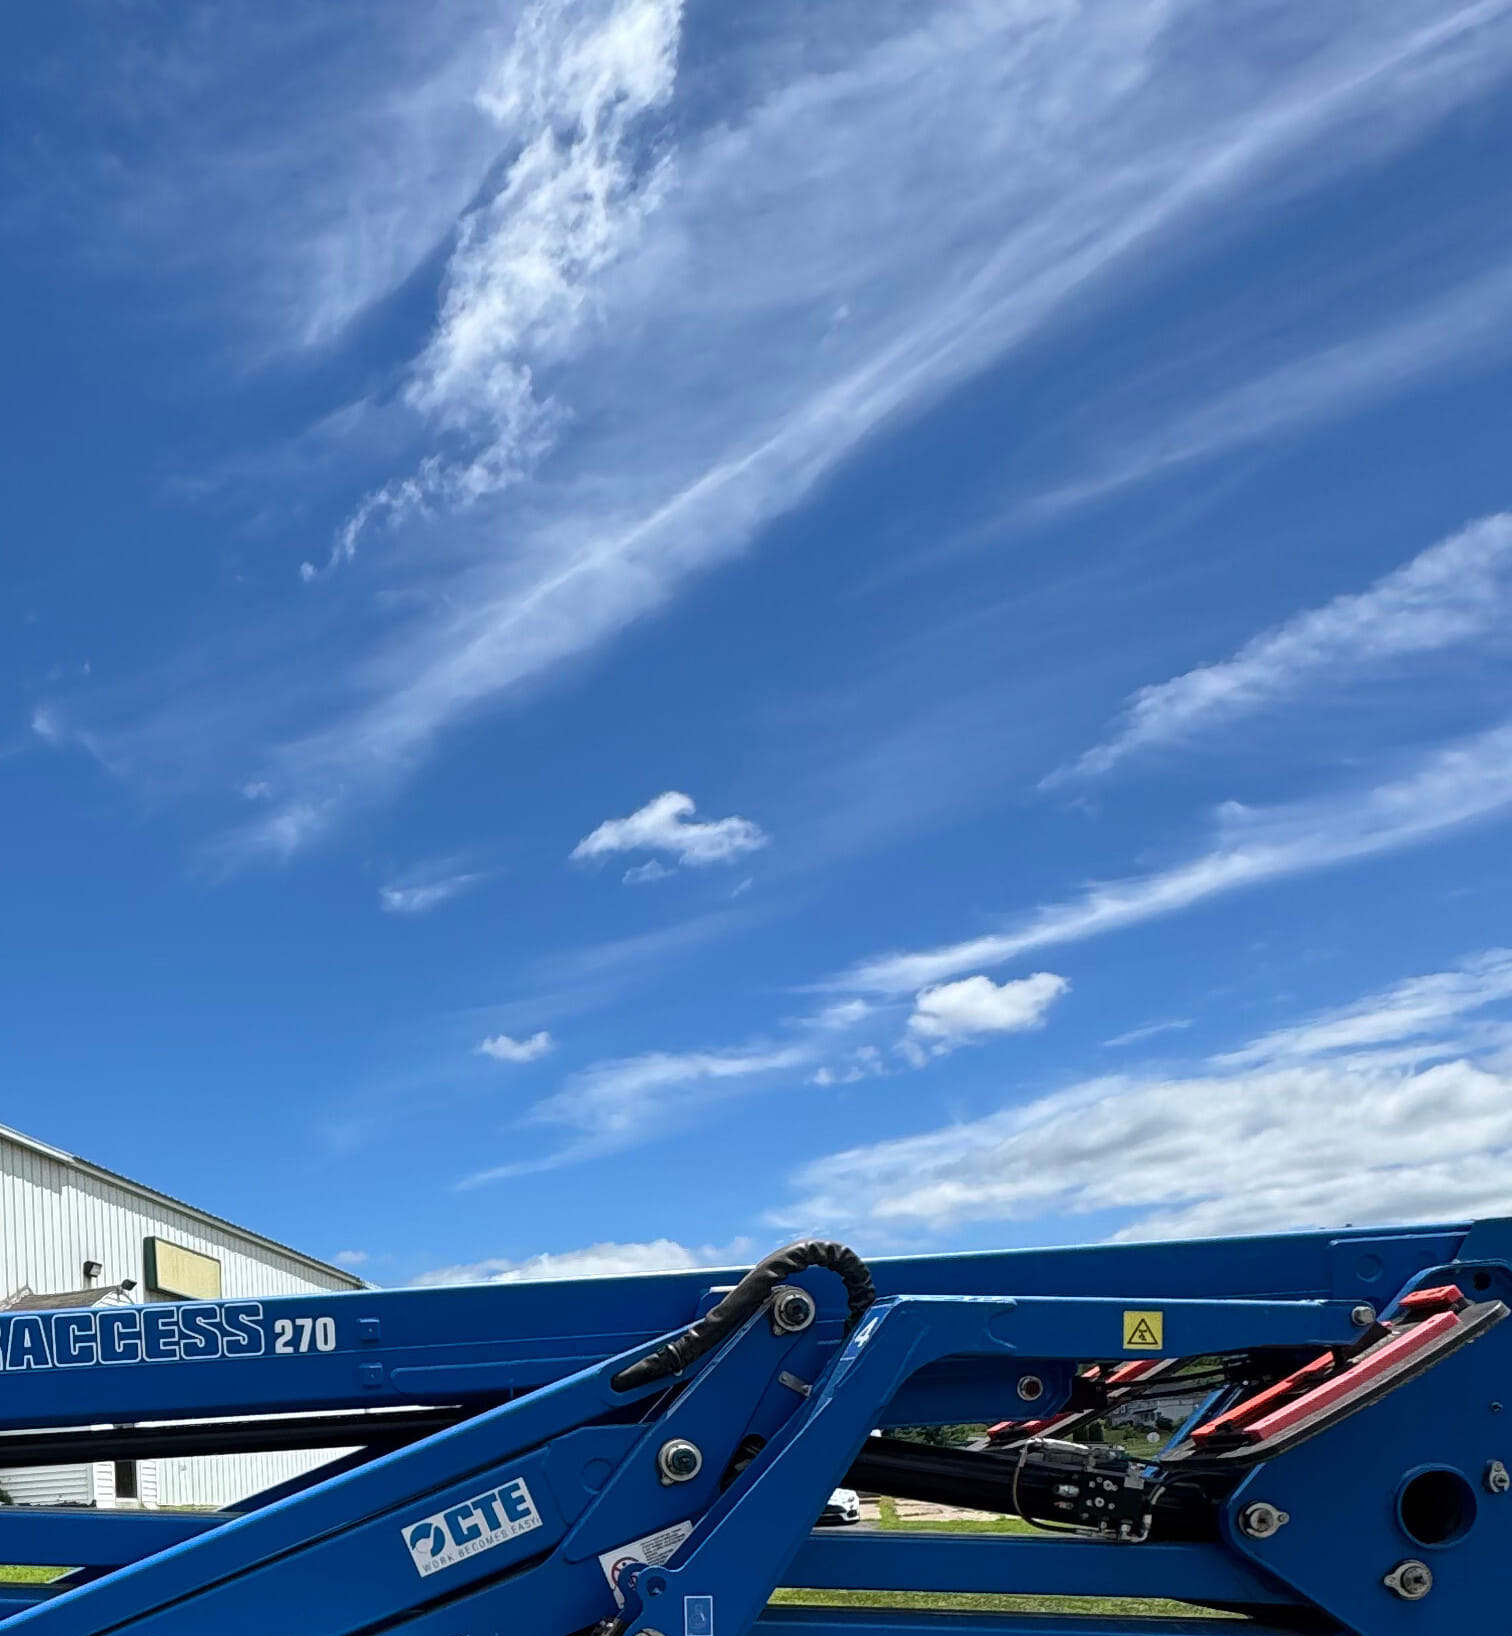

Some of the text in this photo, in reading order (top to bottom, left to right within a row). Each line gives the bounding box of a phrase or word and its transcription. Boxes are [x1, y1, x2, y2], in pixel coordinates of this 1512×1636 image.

[274, 1316, 336, 1354] 270
[854, 1316, 880, 1348] 4
[443, 1482, 532, 1547] CTE
[423, 1552, 455, 1573] WORK
[458, 1530, 508, 1557] BECOMES
